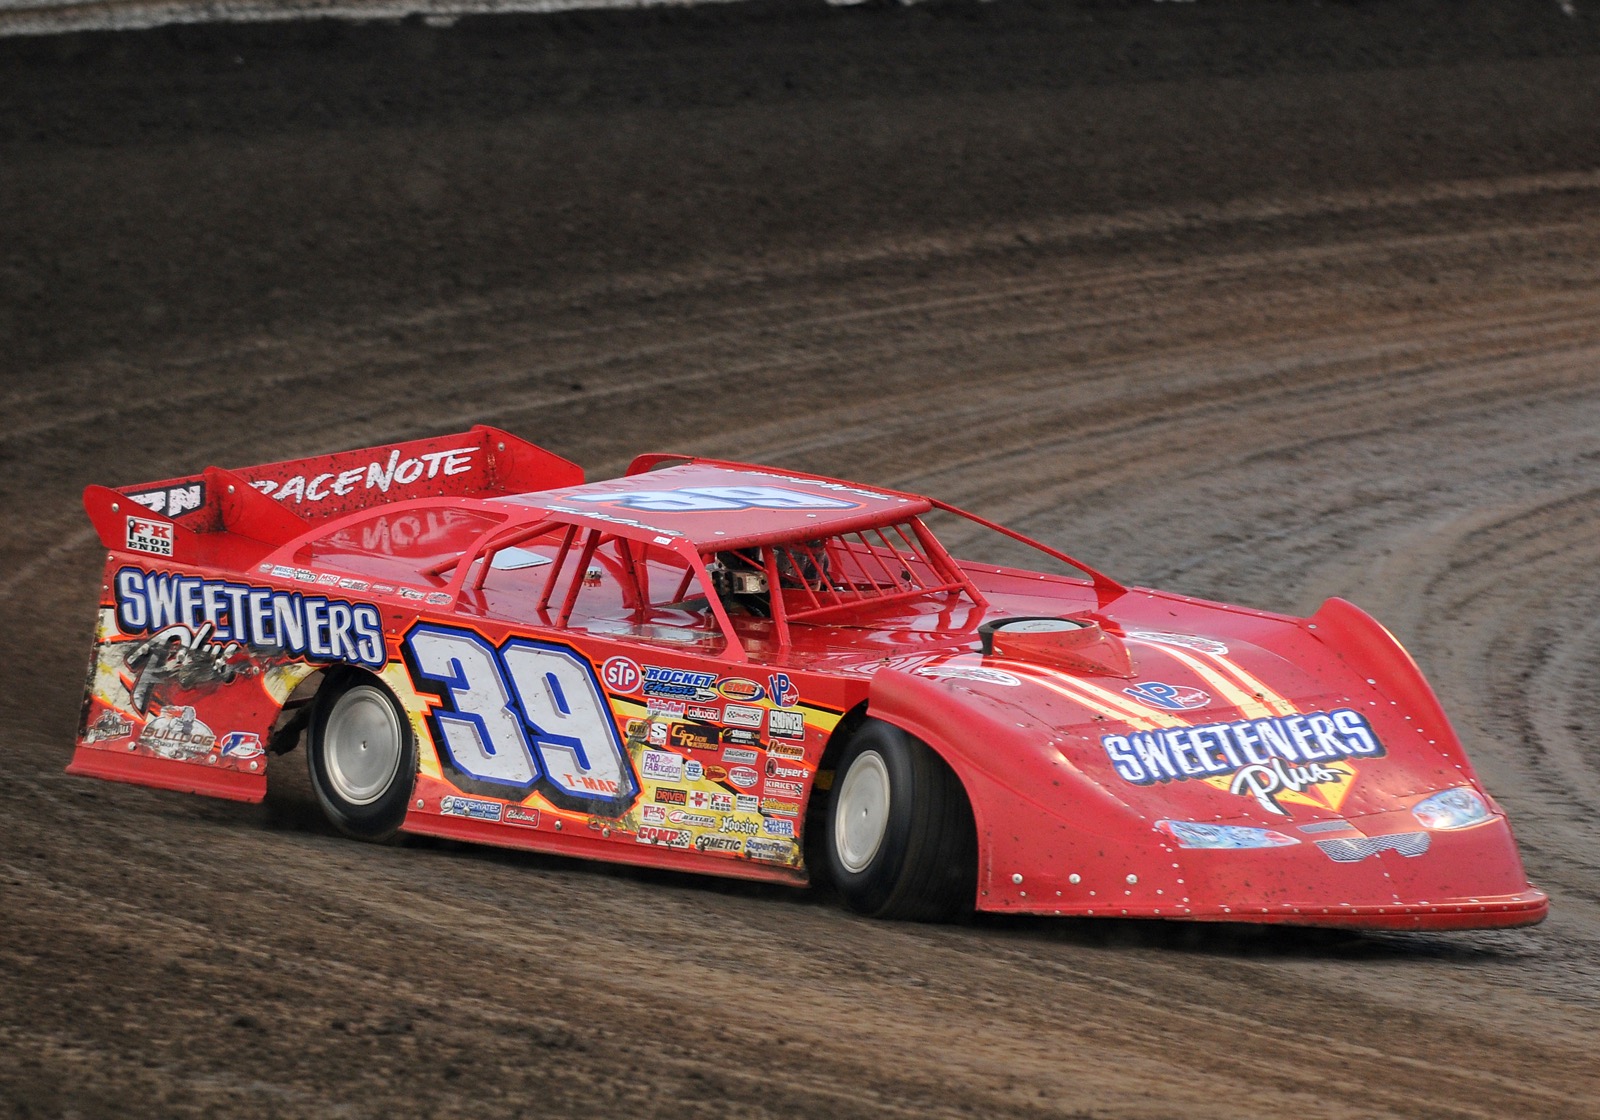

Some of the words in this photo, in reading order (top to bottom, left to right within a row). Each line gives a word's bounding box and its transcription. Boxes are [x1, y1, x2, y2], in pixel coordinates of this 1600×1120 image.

[133, 523, 171, 539] FK
[128, 541, 171, 555] ENDS
[137, 536, 170, 547] ROD
[320, 574, 338, 583] MSD
[115, 568, 385, 668] SWEETENERS
[607, 661, 636, 686] STP
[646, 668, 715, 687] ROCKET
[643, 681, 697, 695] Chassis
[768, 673, 790, 706] VP
[1123, 682, 1178, 709] VP
[407, 626, 638, 800] 39
[142, 727, 215, 746] BULLDOG
[768, 740, 804, 757] Peterson
[1102, 709, 1381, 784] SWEETENERS
[646, 753, 660, 763] PRO
[563, 773, 619, 794] T-MAC
[765, 780, 797, 790] KIRKEY
[1230, 757, 1350, 816] Plus
[656, 790, 686, 803] DRIVEN
[713, 795, 731, 804] FK
[719, 815, 760, 835] Hoosier
[638, 826, 679, 842] COMP
[695, 835, 742, 851] COMETIC
